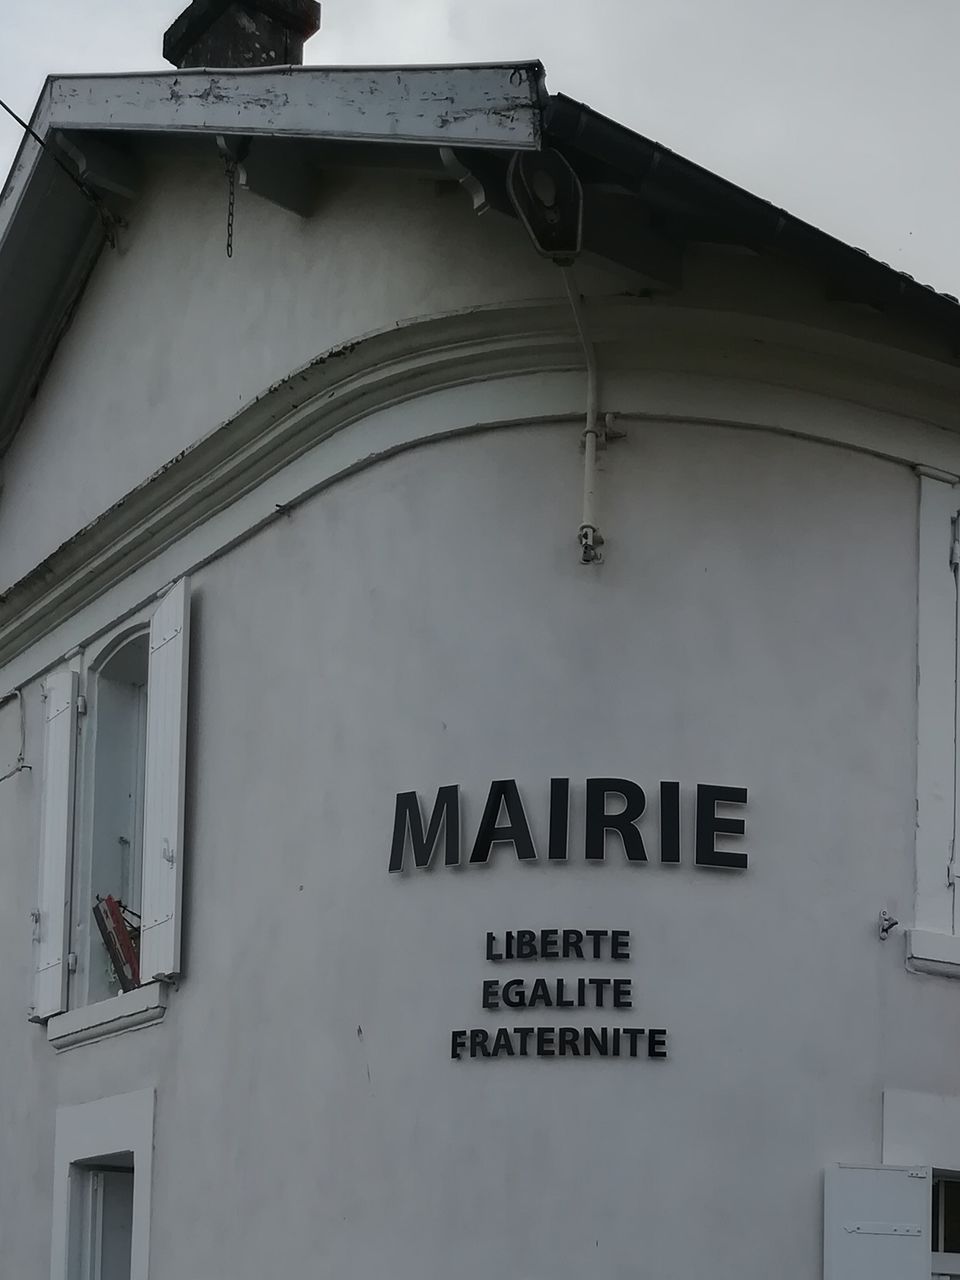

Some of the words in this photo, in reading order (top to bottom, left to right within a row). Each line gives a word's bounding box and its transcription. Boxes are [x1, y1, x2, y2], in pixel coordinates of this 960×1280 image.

[388, 777, 748, 873] MAIRIE
[485, 929, 631, 961] LIBERTE
[482, 978, 633, 1009] EGALITE
[450, 1026, 667, 1059] FRATERNITE
